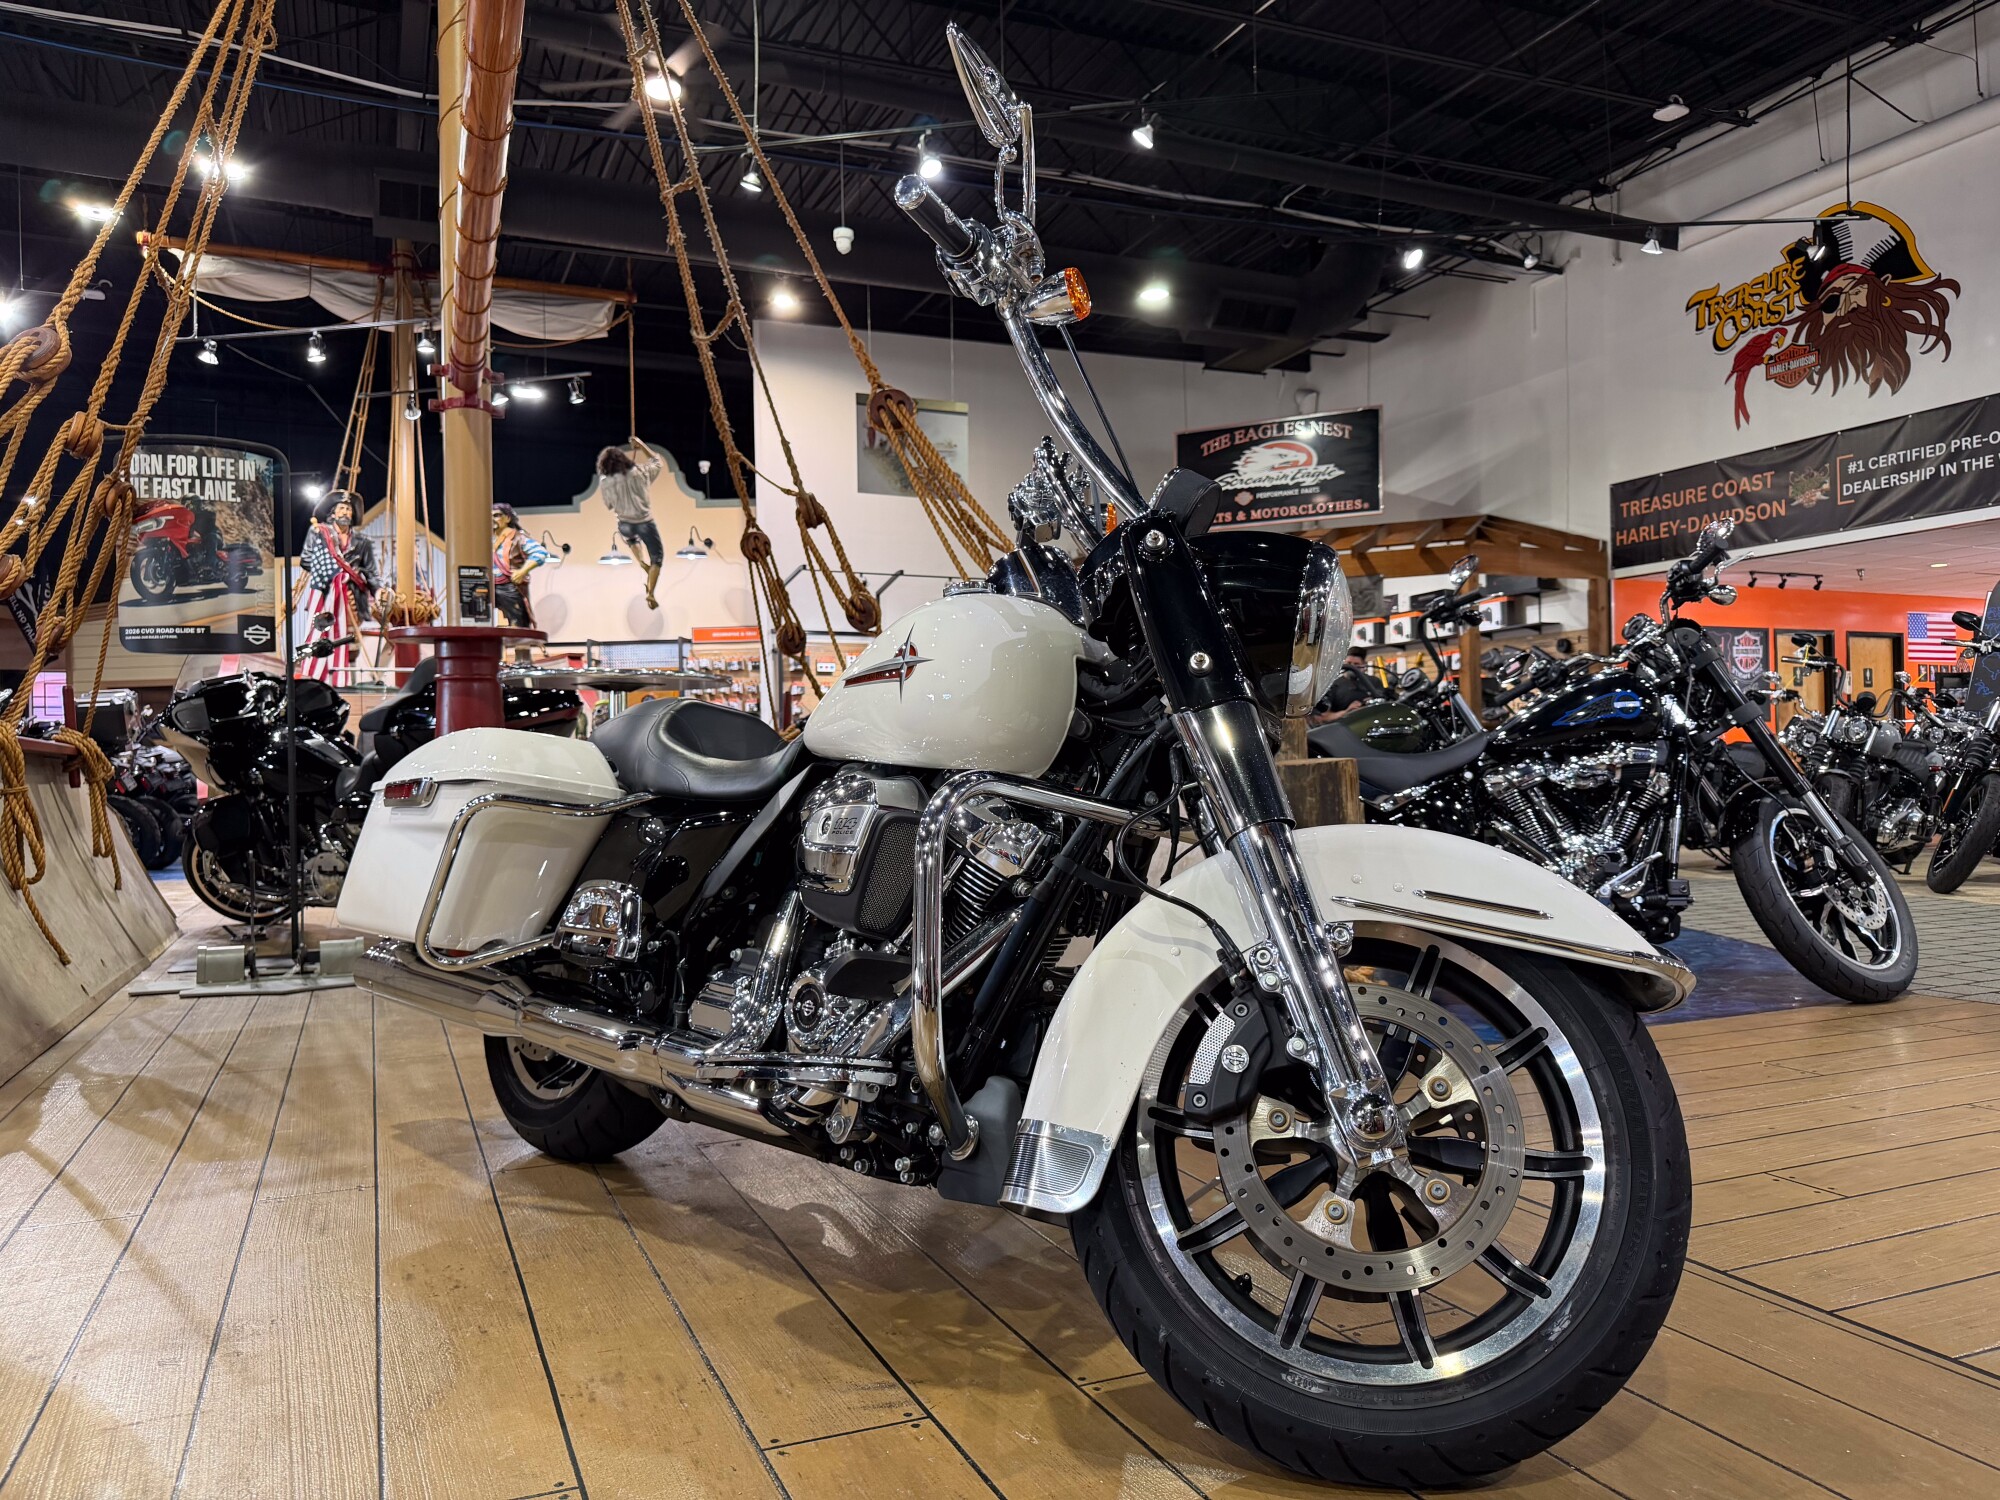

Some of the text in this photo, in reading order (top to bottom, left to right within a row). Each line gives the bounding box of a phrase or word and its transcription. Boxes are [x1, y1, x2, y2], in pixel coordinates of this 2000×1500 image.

[1685, 256, 1806, 332] TREASURE
[1713, 283, 1801, 351] COAST
[1769, 353, 1817, 376] HARLEY-DAVIDSON
[1200, 431, 1232, 457] THE
[1309, 421, 1353, 440] NEST
[129, 453, 256, 482] ORN FOR LIFE IN
[1842, 466, 1936, 496] DEALERSHIP
[1940, 462, 1957, 478] IN
[1961, 454, 1995, 473] THE
[1847, 461, 1865, 475] #1
[1868, 442, 1947, 470] CERTIFIED
[152, 477, 192, 499] FAST
[194, 479, 242, 503] LANE.
[1619, 470, 1776, 519] TREASURE COAST
[1235, 510, 1248, 522] &
[1615, 499, 1787, 547] HARLEY-DAVIDSON
[140, 627, 155, 635] CVO
[155, 627, 174, 635] ROAD
[174, 627, 195, 635] GLIDE
[834, 817, 858, 830] 114
